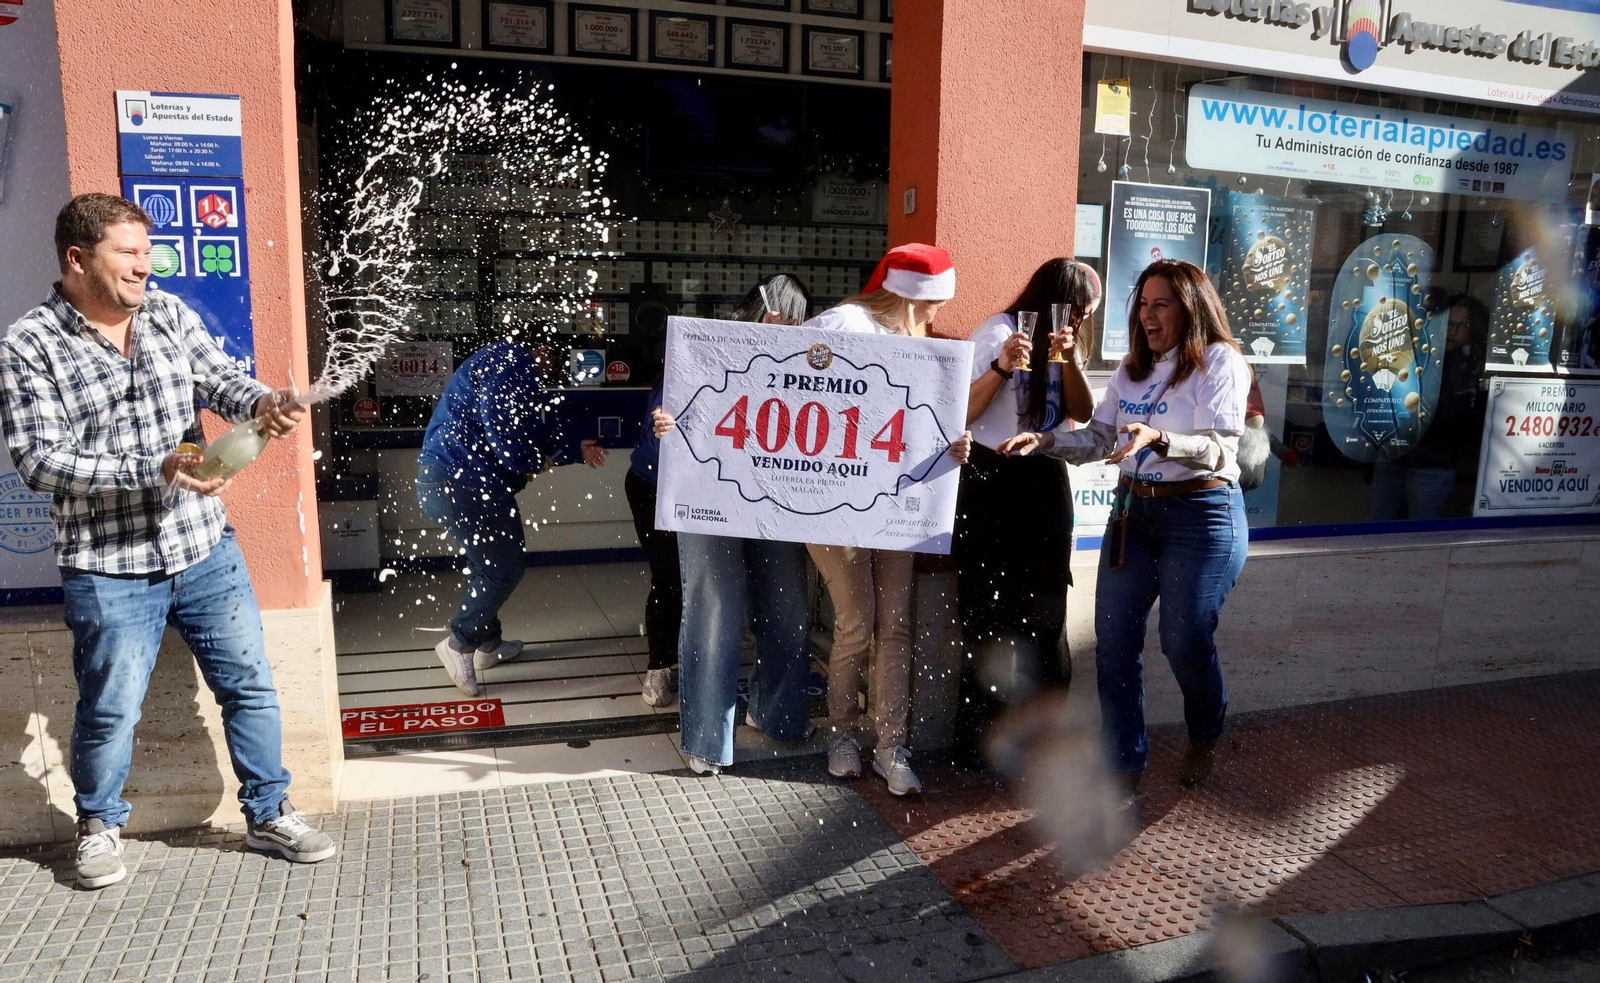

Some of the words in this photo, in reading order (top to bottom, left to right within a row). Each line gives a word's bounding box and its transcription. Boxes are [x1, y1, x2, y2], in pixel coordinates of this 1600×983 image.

[500, 17, 530, 26] 721.214
[585, 24, 619, 33] 1.000.000
[1392, 12, 1507, 57] Apuestas
[1508, 30, 1552, 64] del
[1516, 90, 1525, 101] La
[1527, 92, 1552, 104] Piedad
[150, 103, 184, 111] Loterías
[152, 112, 189, 121] Apuestas
[192, 113, 204, 121] del
[206, 114, 233, 122] Estado
[1202, 100, 1567, 161] www.loterialapiedad.es
[1256, 134, 1271, 148] Tu
[1275, 136, 1373, 160] Administración
[1377, 149, 1391, 162] de
[1395, 151, 1451, 169] confianza
[1455, 157, 1489, 172] desde
[1493, 161, 1519, 176] 1987
[1323, 163, 1335, 171] +18
[1385, 170, 1402, 178] 100%
[823, 186, 866, 196] 1.000.000
[1123, 207, 1133, 219] ES
[1133, 208, 1147, 220] UNA
[1148, 209, 1165, 221] COSA
[1166, 211, 1179, 222] QUE
[1180, 212, 1196, 224] PASA
[1165, 222, 1177, 233] LOS
[1178, 220, 1195, 234] DÍAS.
[1267, 243, 1277, 252] EL
[1253, 246, 1286, 267] SORTEO
[1254, 270, 1268, 283] NOS
[1268, 263, 1284, 278] UNE
[1388, 309, 1398, 320] EL
[1370, 312, 1408, 338] SORTEO
[717, 335, 728, 343] DE
[1372, 343, 1388, 357] NOS
[1388, 333, 1406, 350] UNE
[902, 352, 913, 360] DE
[914, 353, 957, 363] DICIEMBRE
[390, 359, 439, 374] 40014
[612, 364, 624, 372] +18
[783, 373, 868, 396] PREMIO
[1541, 386, 1576, 398] PREMIO
[359, 401, 373, 409] +18
[1525, 402, 1585, 413] MILLONARIO
[715, 395, 906, 463] 40014
[1505, 415, 1592, 437] 2.480.932
[1593, 426, 1600, 436] €
[752, 455, 823, 473] VENDIDO
[827, 462, 869, 477] AQUÍ
[1535, 466, 1550, 474] Bono
[1564, 466, 1578, 474] Loto
[817, 479, 847, 488] PIEDAD
[1499, 479, 1553, 493] VENDIDO
[1557, 475, 1590, 492] AQUÍ
[691, 508, 721, 516] LOTERÍA
[691, 514, 728, 523] NACIONAL
[886, 517, 938, 528] COMPARTIRLO
[360, 722, 395, 733] EL
[404, 715, 479, 730] PASO
